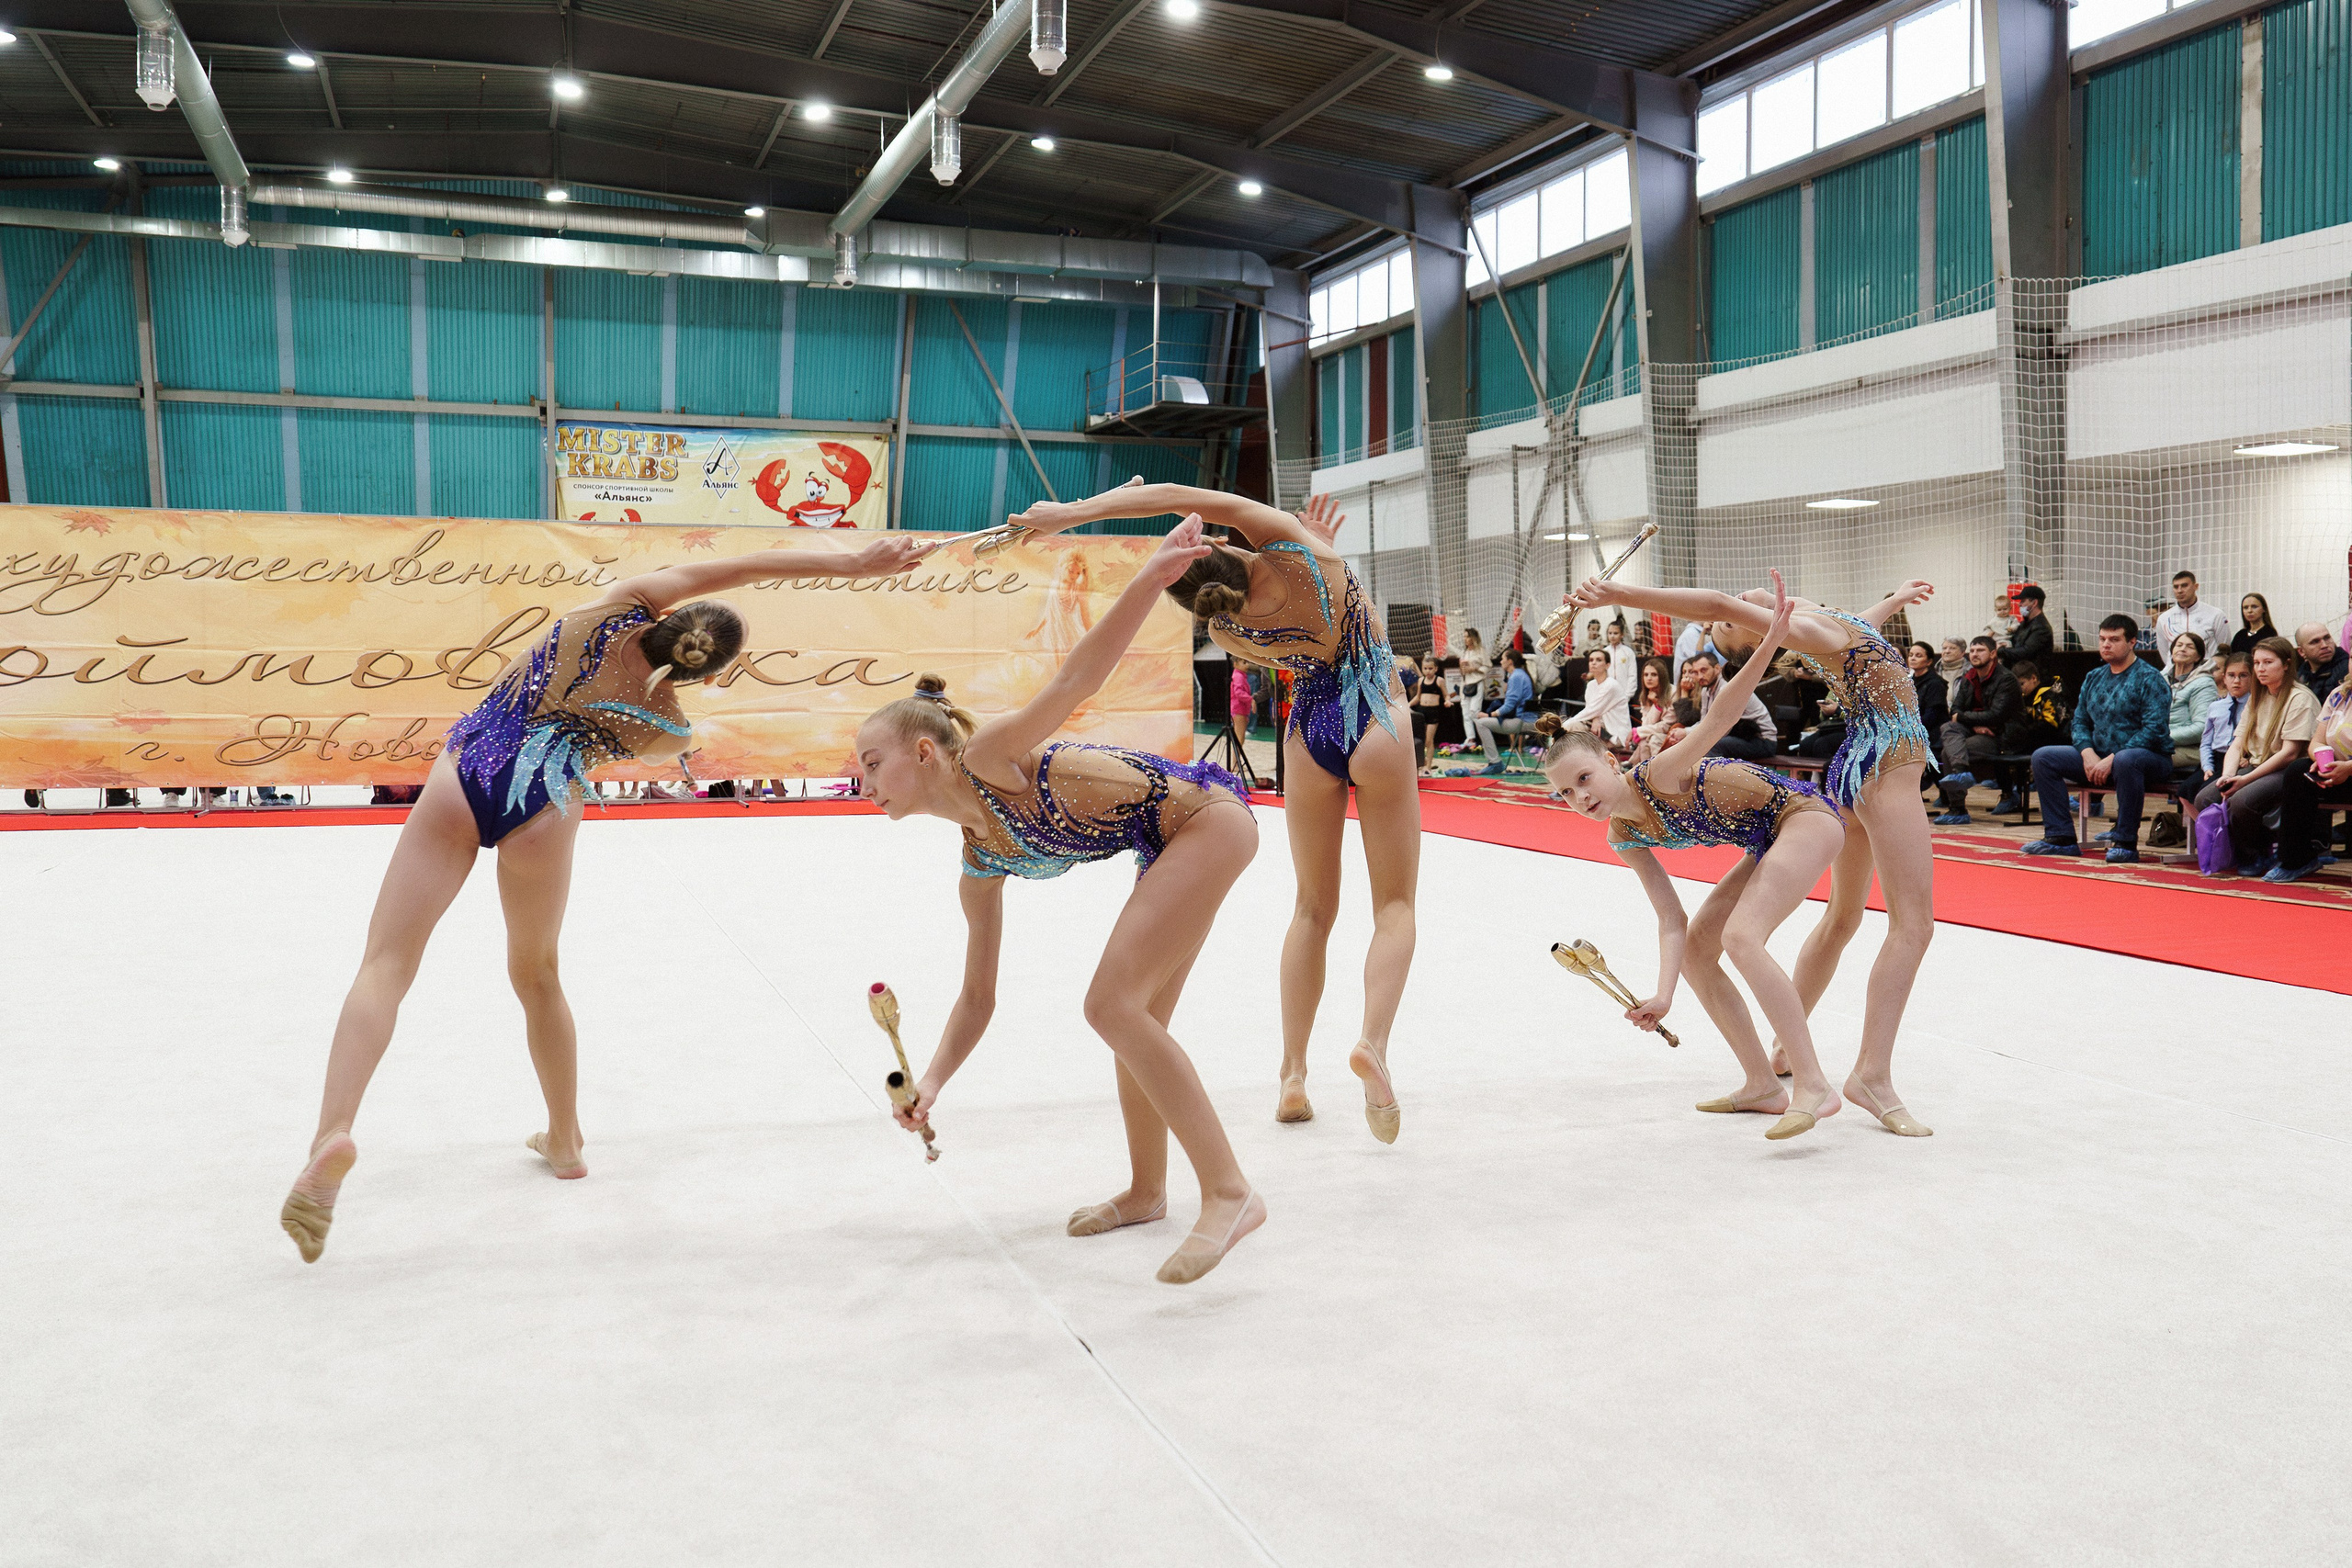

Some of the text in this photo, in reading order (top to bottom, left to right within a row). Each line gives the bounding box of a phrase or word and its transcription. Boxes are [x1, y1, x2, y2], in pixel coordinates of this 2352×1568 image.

[556, 426, 688, 457] MISTER
[567, 452, 679, 480] KRABS
[594, 491, 652, 502] «Альянс»
[0, 528, 617, 615] художественной
[125, 712, 446, 767] г. Ново
